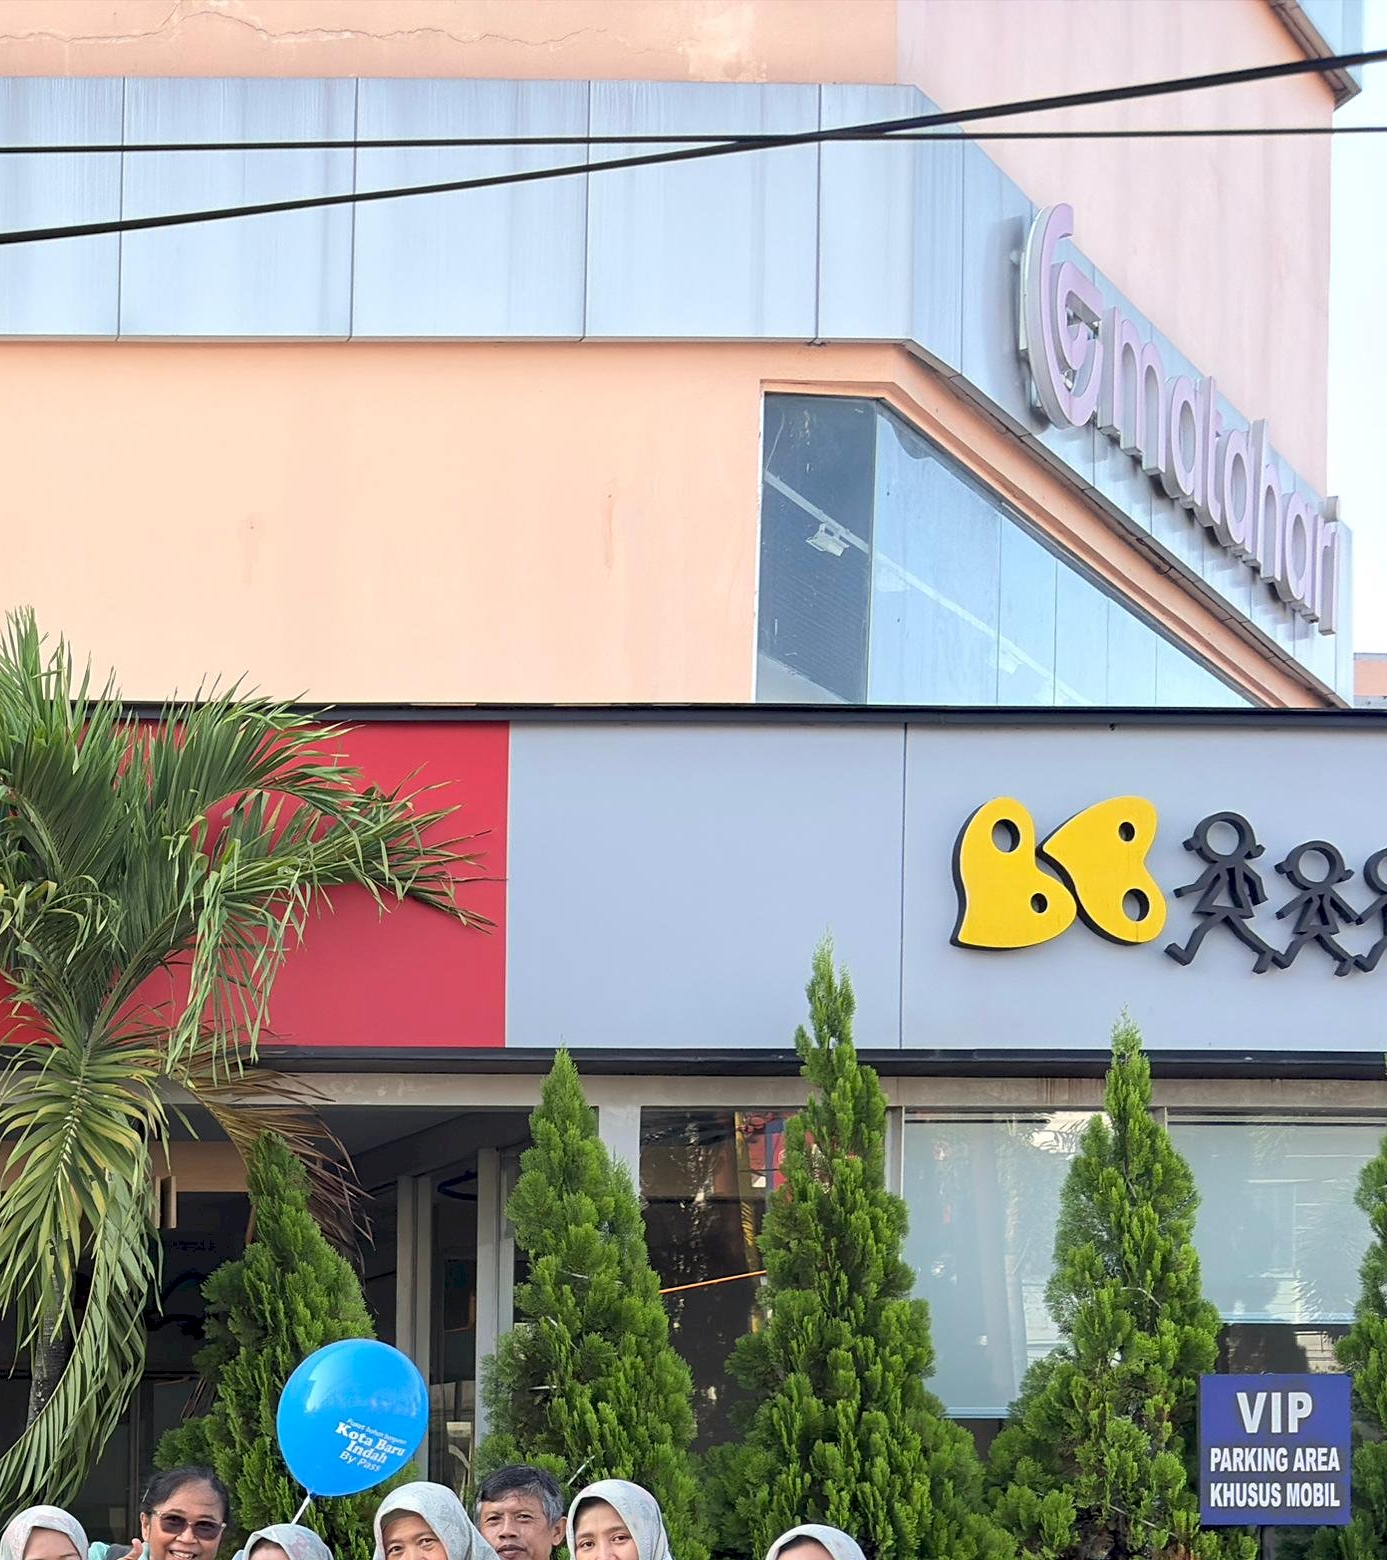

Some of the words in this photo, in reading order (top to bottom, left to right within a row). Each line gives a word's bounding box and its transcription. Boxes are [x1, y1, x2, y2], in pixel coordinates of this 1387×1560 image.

[1098, 305, 1339, 635] matahari
[1236, 1392, 1313, 1433] VIP
[335, 1422, 374, 1447] Kota
[375, 1438, 406, 1456] Baru
[339, 1450, 357, 1465] By
[357, 1458, 382, 1472] Pass
[346, 1440, 388, 1464] Indah
[1210, 1448, 1288, 1472] PARKING
[1293, 1447, 1340, 1471] AREA
[1210, 1483, 1281, 1507] KHUSUS
[1286, 1483, 1340, 1507] MOBIL
